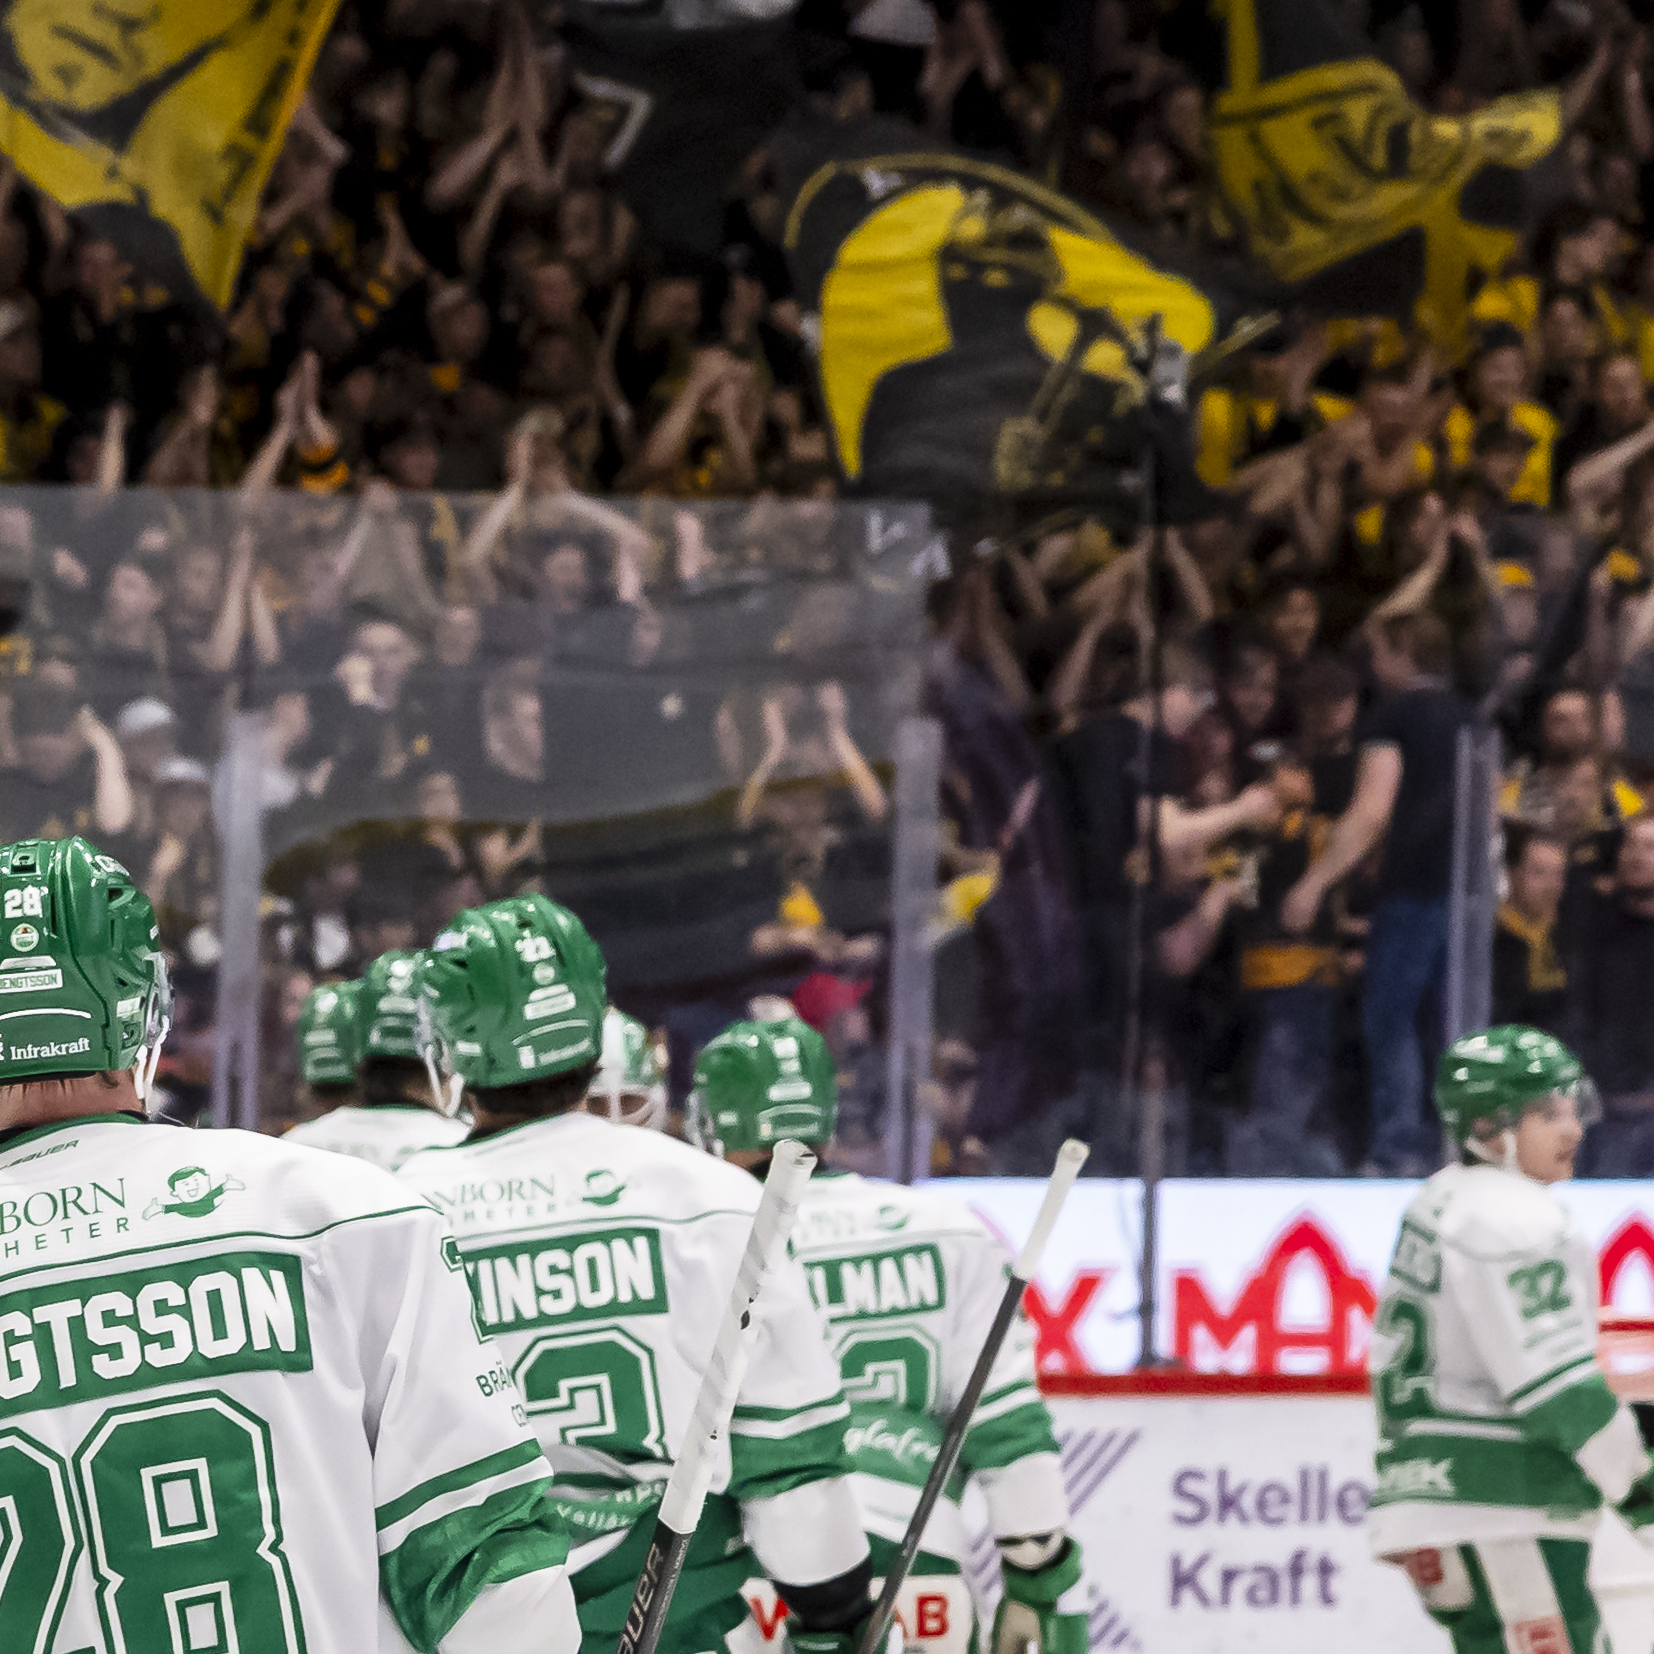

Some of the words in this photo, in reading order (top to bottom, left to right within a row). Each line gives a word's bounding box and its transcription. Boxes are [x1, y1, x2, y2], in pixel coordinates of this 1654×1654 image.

[4, 886, 43, 918] 28
[10, 1037, 90, 1060] Infrakraft
[465, 1235, 656, 1326] INSON
[809, 1252, 939, 1315] LMAN
[1507, 1258, 1572, 1321] 32
[1170, 1466, 1371, 1528] Skelle
[1170, 1549, 1339, 1610] Kraft
